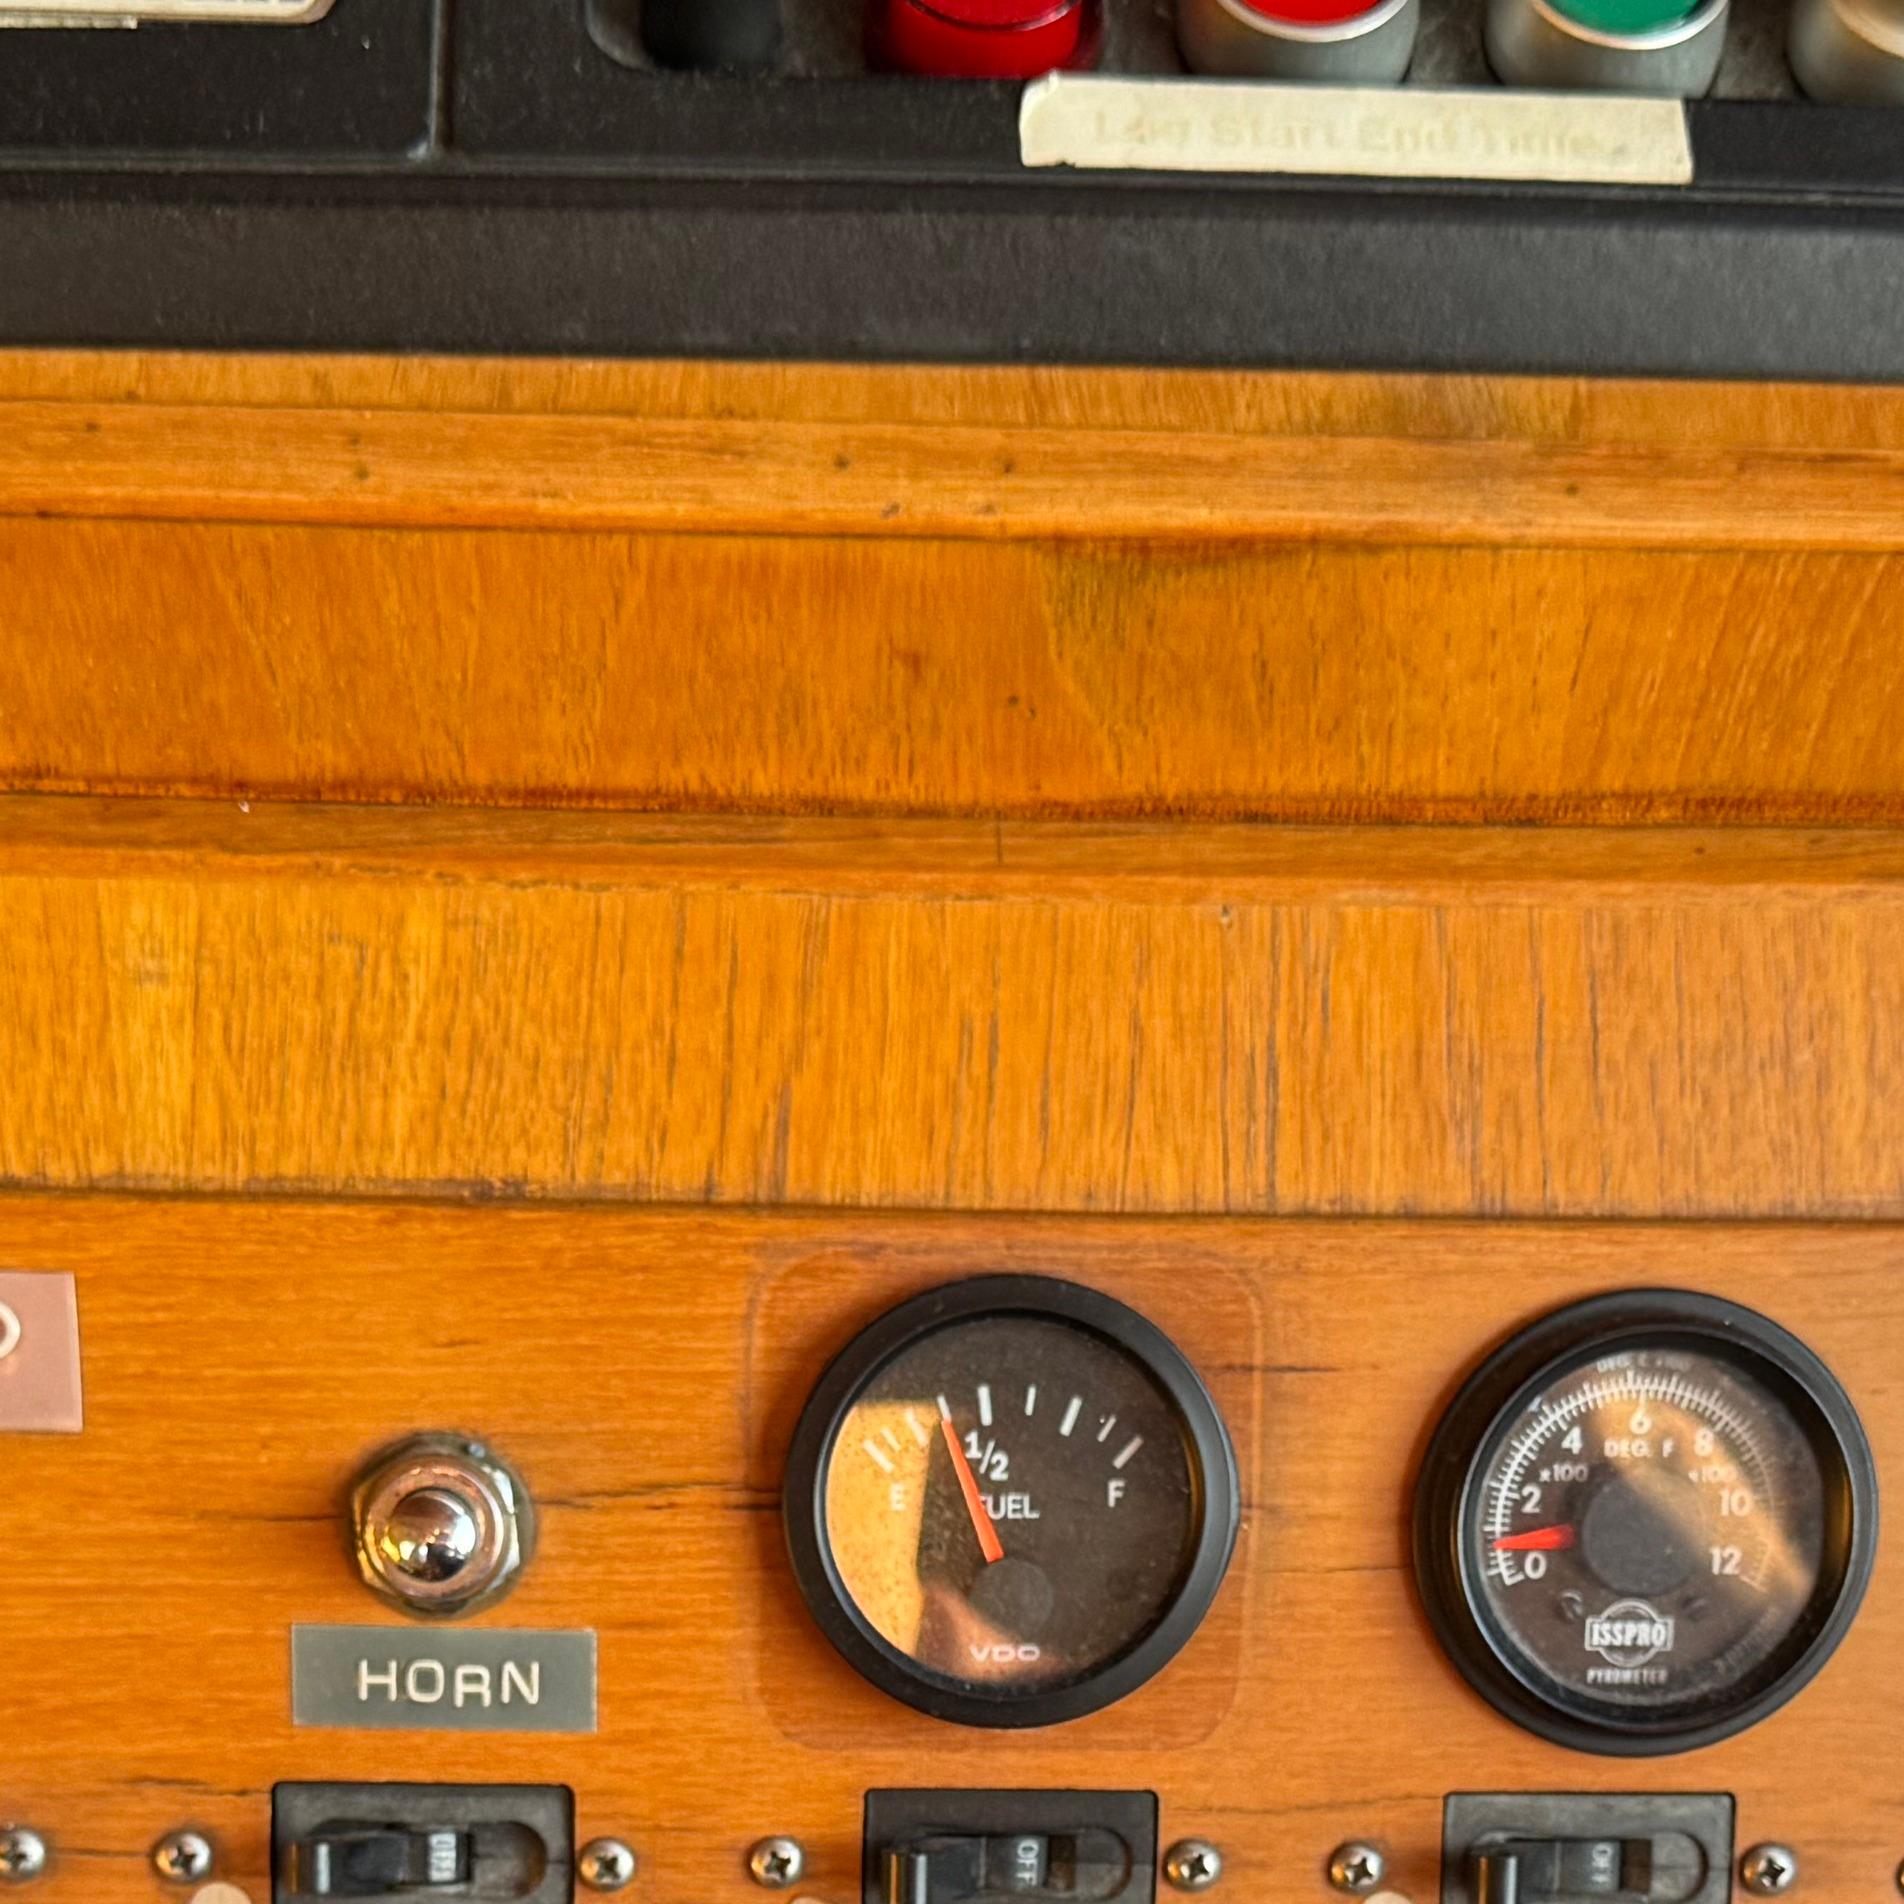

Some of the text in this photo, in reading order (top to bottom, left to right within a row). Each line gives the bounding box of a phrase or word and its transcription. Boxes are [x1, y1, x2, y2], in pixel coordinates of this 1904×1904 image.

[1630, 1409, 1652, 1434] 6
[1562, 1428, 1583, 1455] 4
[1604, 1441, 1674, 1459] DEG. F
[1694, 1434, 1716, 1456] 8
[964, 1431, 1009, 1481] 1/2
[889, 1483, 907, 1511] E
[1107, 1480, 1126, 1508] F
[1521, 1487, 1541, 1514] 2
[1721, 1489, 1753, 1517] 10
[1524, 1552, 1546, 1580] 0
[1710, 1547, 1740, 1576] 12
[1591, 1619, 1667, 1647] ISSPRO
[970, 1645, 1040, 1662] VDO
[355, 1656, 540, 1709] HORN
[1587, 1667, 1667, 1685] PYROMETER
[1015, 1837, 1039, 1891] OFF
